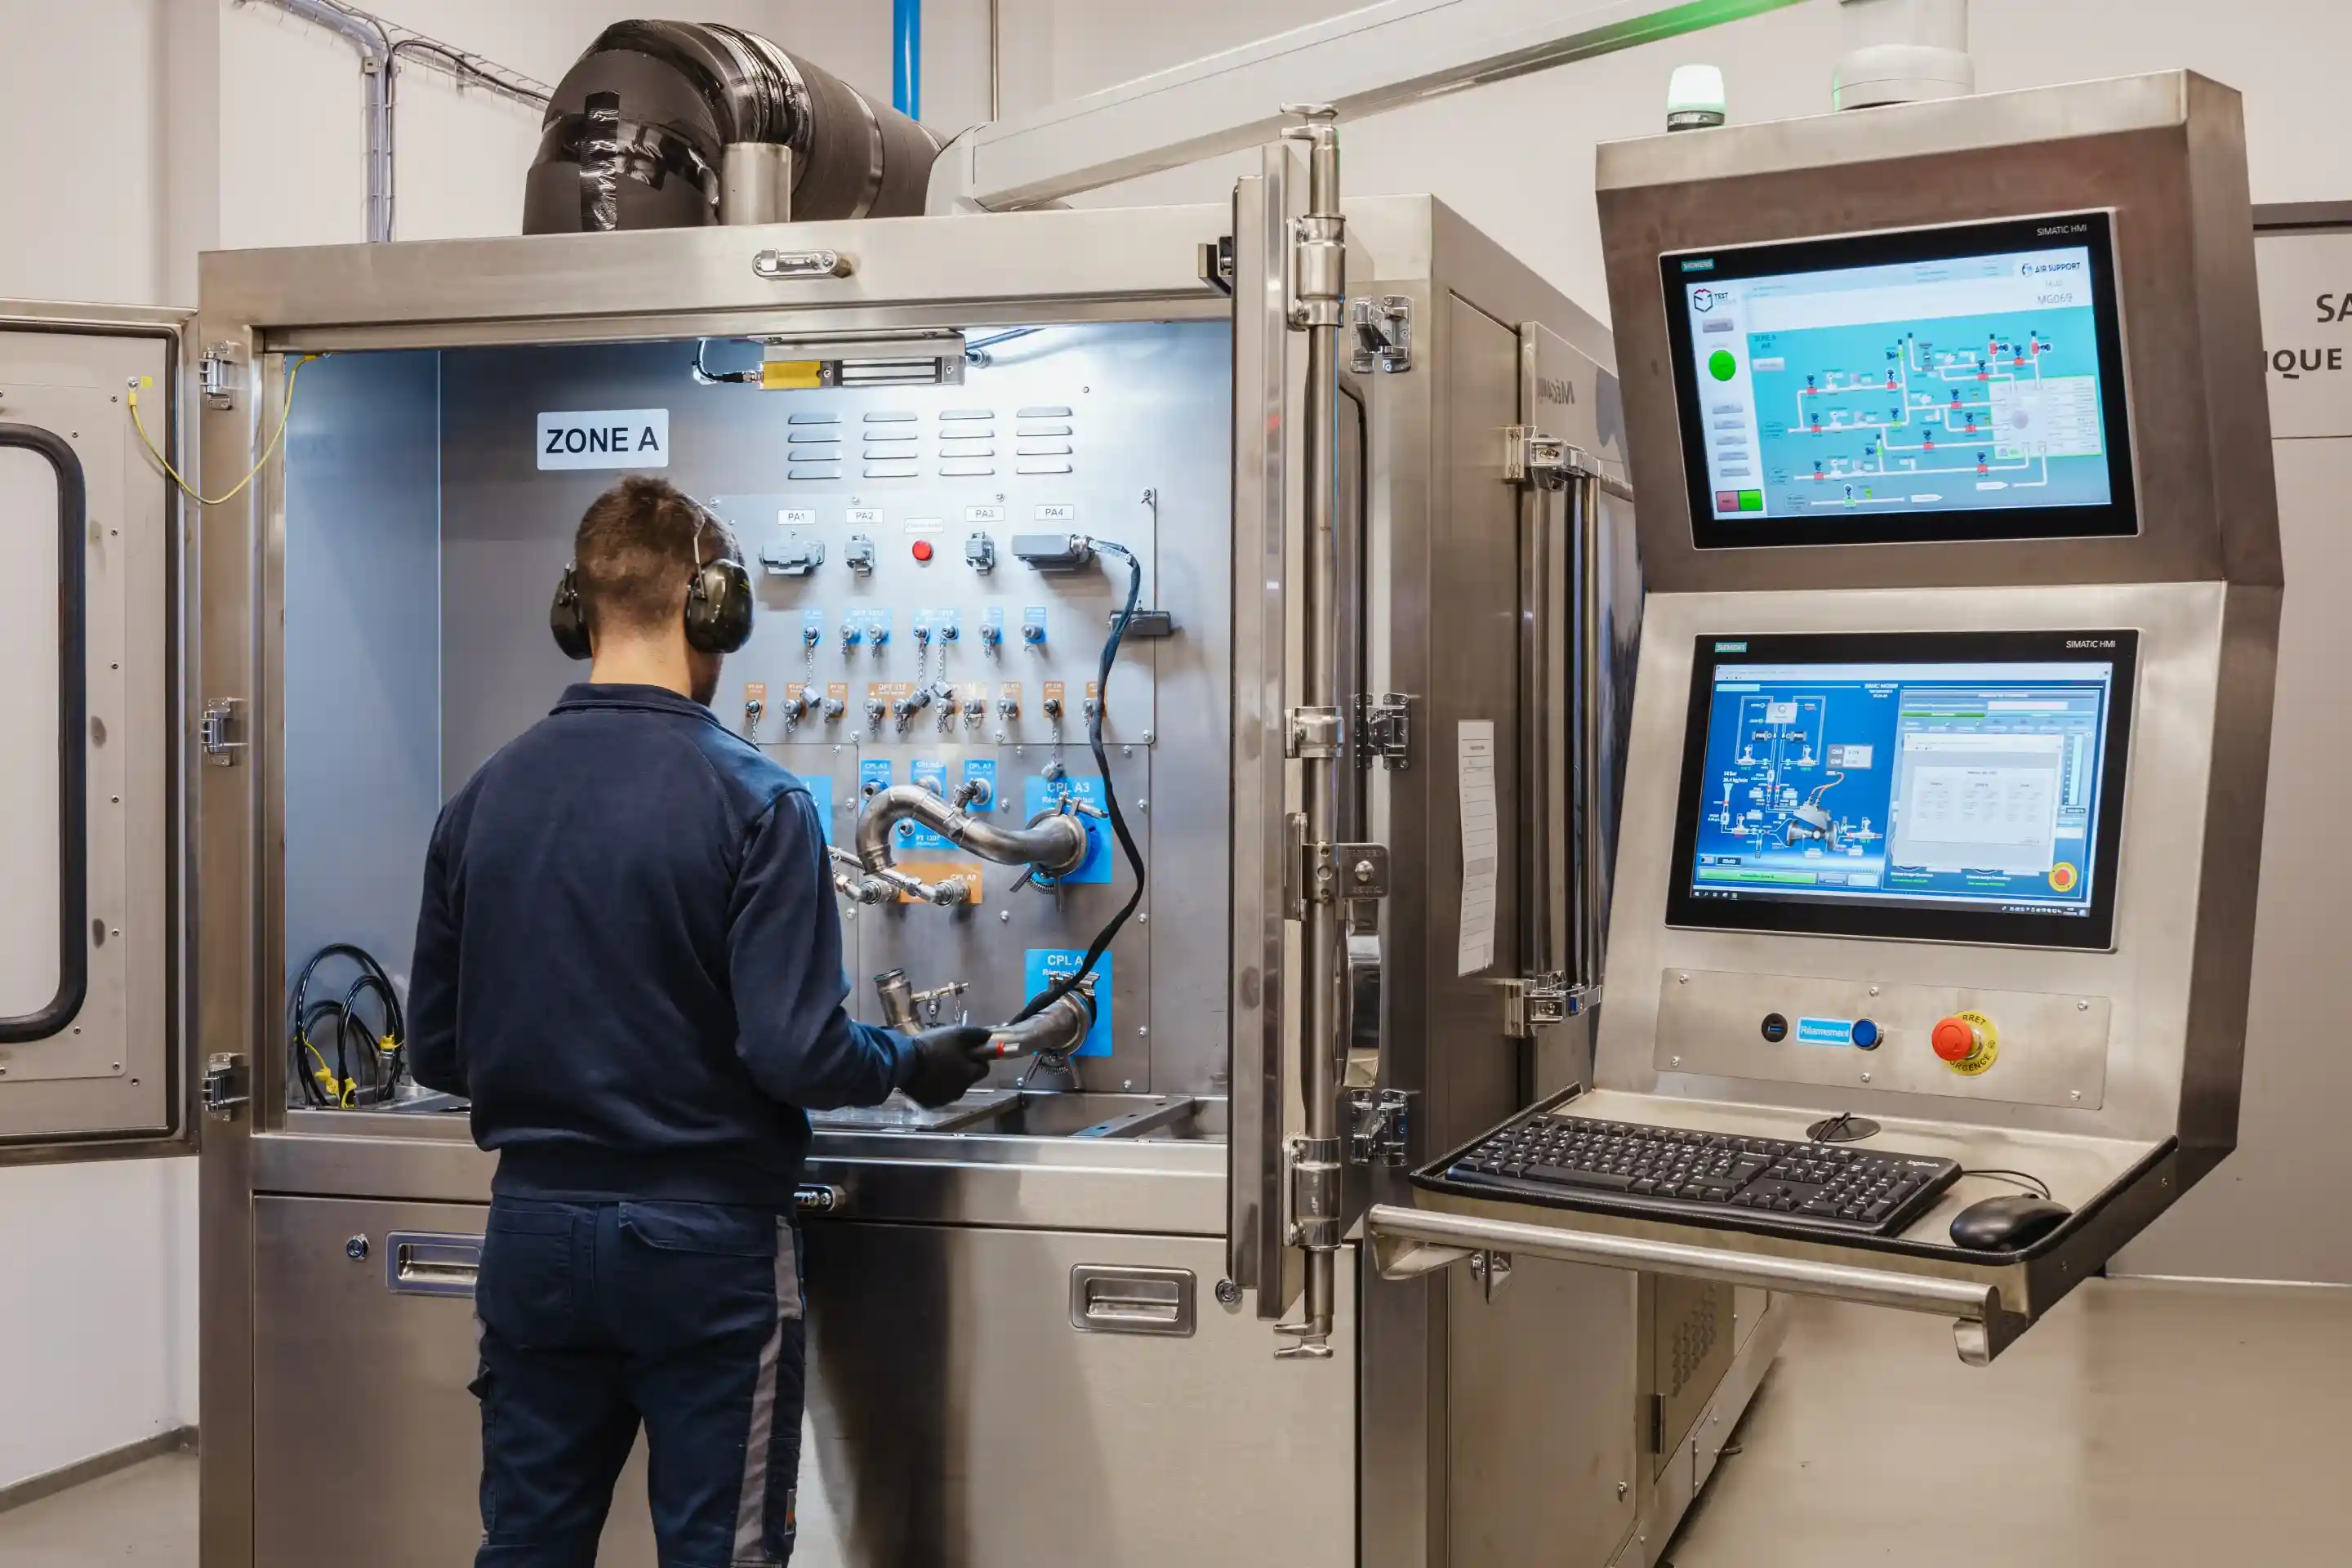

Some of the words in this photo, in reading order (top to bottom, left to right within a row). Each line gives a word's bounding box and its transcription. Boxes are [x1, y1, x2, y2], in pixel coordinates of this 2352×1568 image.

[2037, 225, 2069, 236] SIMATIC
[2070, 224, 2087, 233] HMI
[2034, 265, 2047, 274] AIR
[2048, 262, 2081, 272] SUPPORT
[2038, 293, 2073, 304] MG069
[2316, 292, 2352, 323] SA
[546, 427, 629, 454] ZONE
[637, 426, 660, 452] A
[788, 512, 804, 522] PA1
[856, 511, 874, 520] PA2
[976, 510, 994, 519] PA3
[1045, 508, 1063, 517] PA4
[1717, 644, 1745, 652] SIEMENS
[2066, 640, 2098, 648] SIMATIC
[1047, 782, 1071, 793] CPL
[1075, 782, 1089, 792] A3
[1047, 955, 1071, 966] CPL
[1962, 1014, 1986, 1026] RRET
[1800, 1026, 1849, 1037] Réarmement
